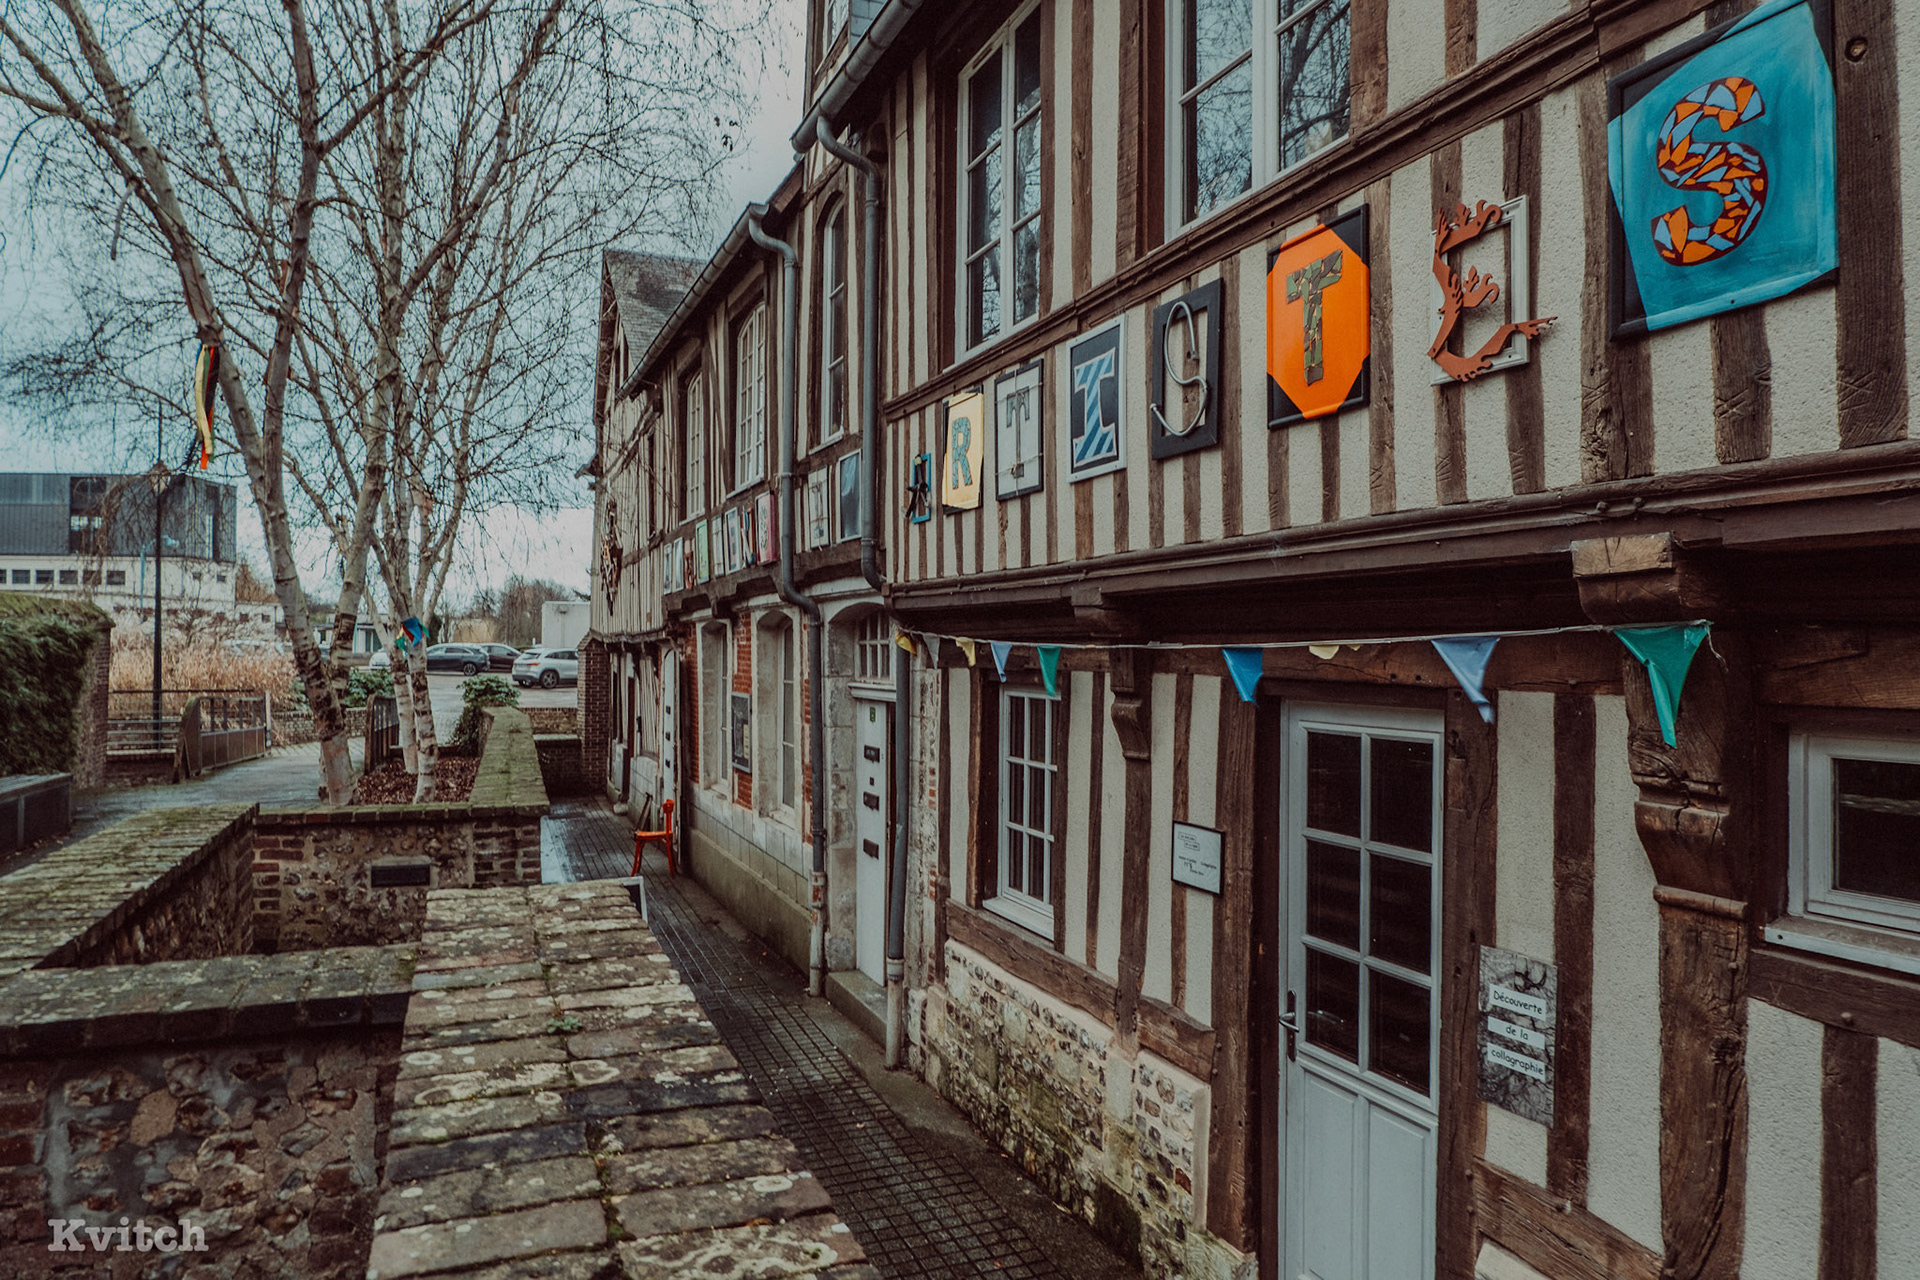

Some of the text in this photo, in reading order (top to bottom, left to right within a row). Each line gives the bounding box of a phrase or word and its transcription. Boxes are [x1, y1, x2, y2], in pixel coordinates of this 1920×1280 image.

[1493, 990, 1543, 1015] Découverte
[1506, 1025, 1529, 1040] de la
[1491, 1049, 1544, 1076] collagraphie
